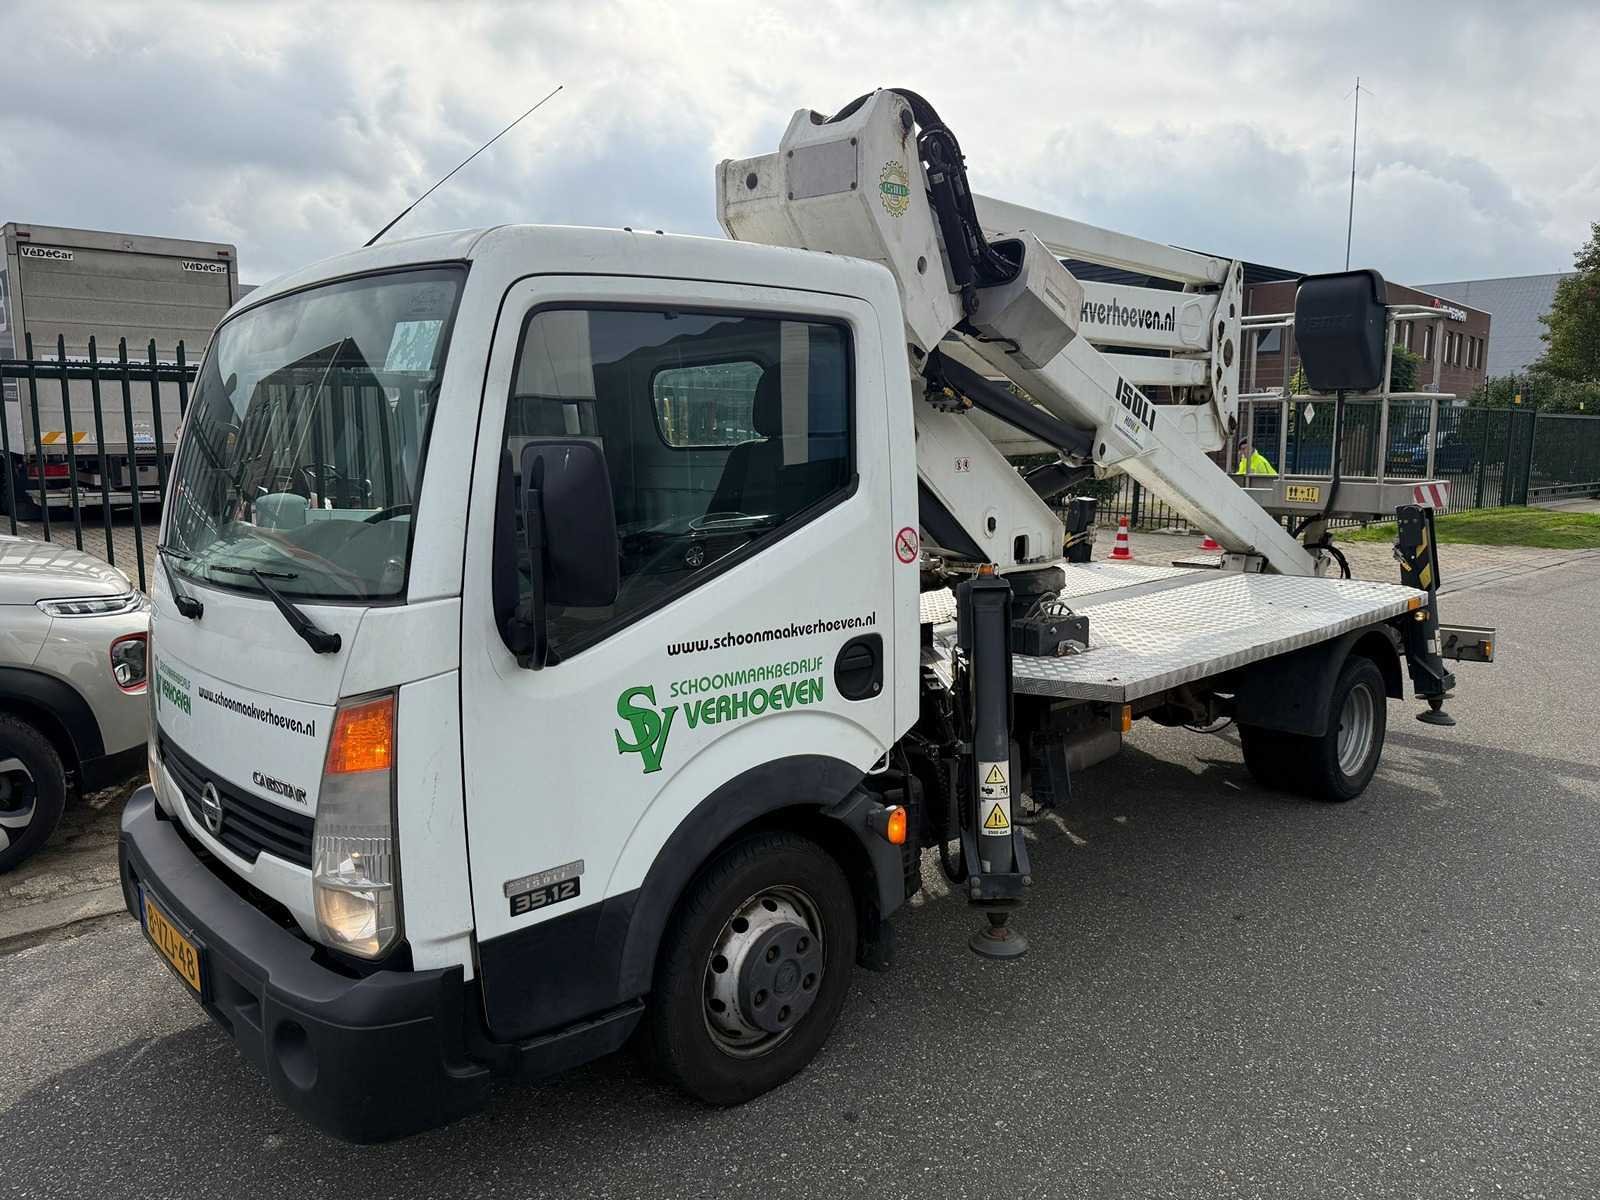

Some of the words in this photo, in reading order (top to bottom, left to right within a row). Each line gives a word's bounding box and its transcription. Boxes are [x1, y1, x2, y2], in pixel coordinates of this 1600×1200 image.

[1115, 375, 1156, 431] ISOLI
[667, 611, 876, 656] www.schoonmaakverhoeven.nl
[670, 656, 824, 698] SCHOONMAAKBEDRIJF
[198, 686, 316, 737] www.schoonmaakverhoeven.nl
[684, 676, 824, 729] VERHOEVEN
[252, 771, 307, 805] CABSTAR
[515, 881, 576, 913] 35.12
